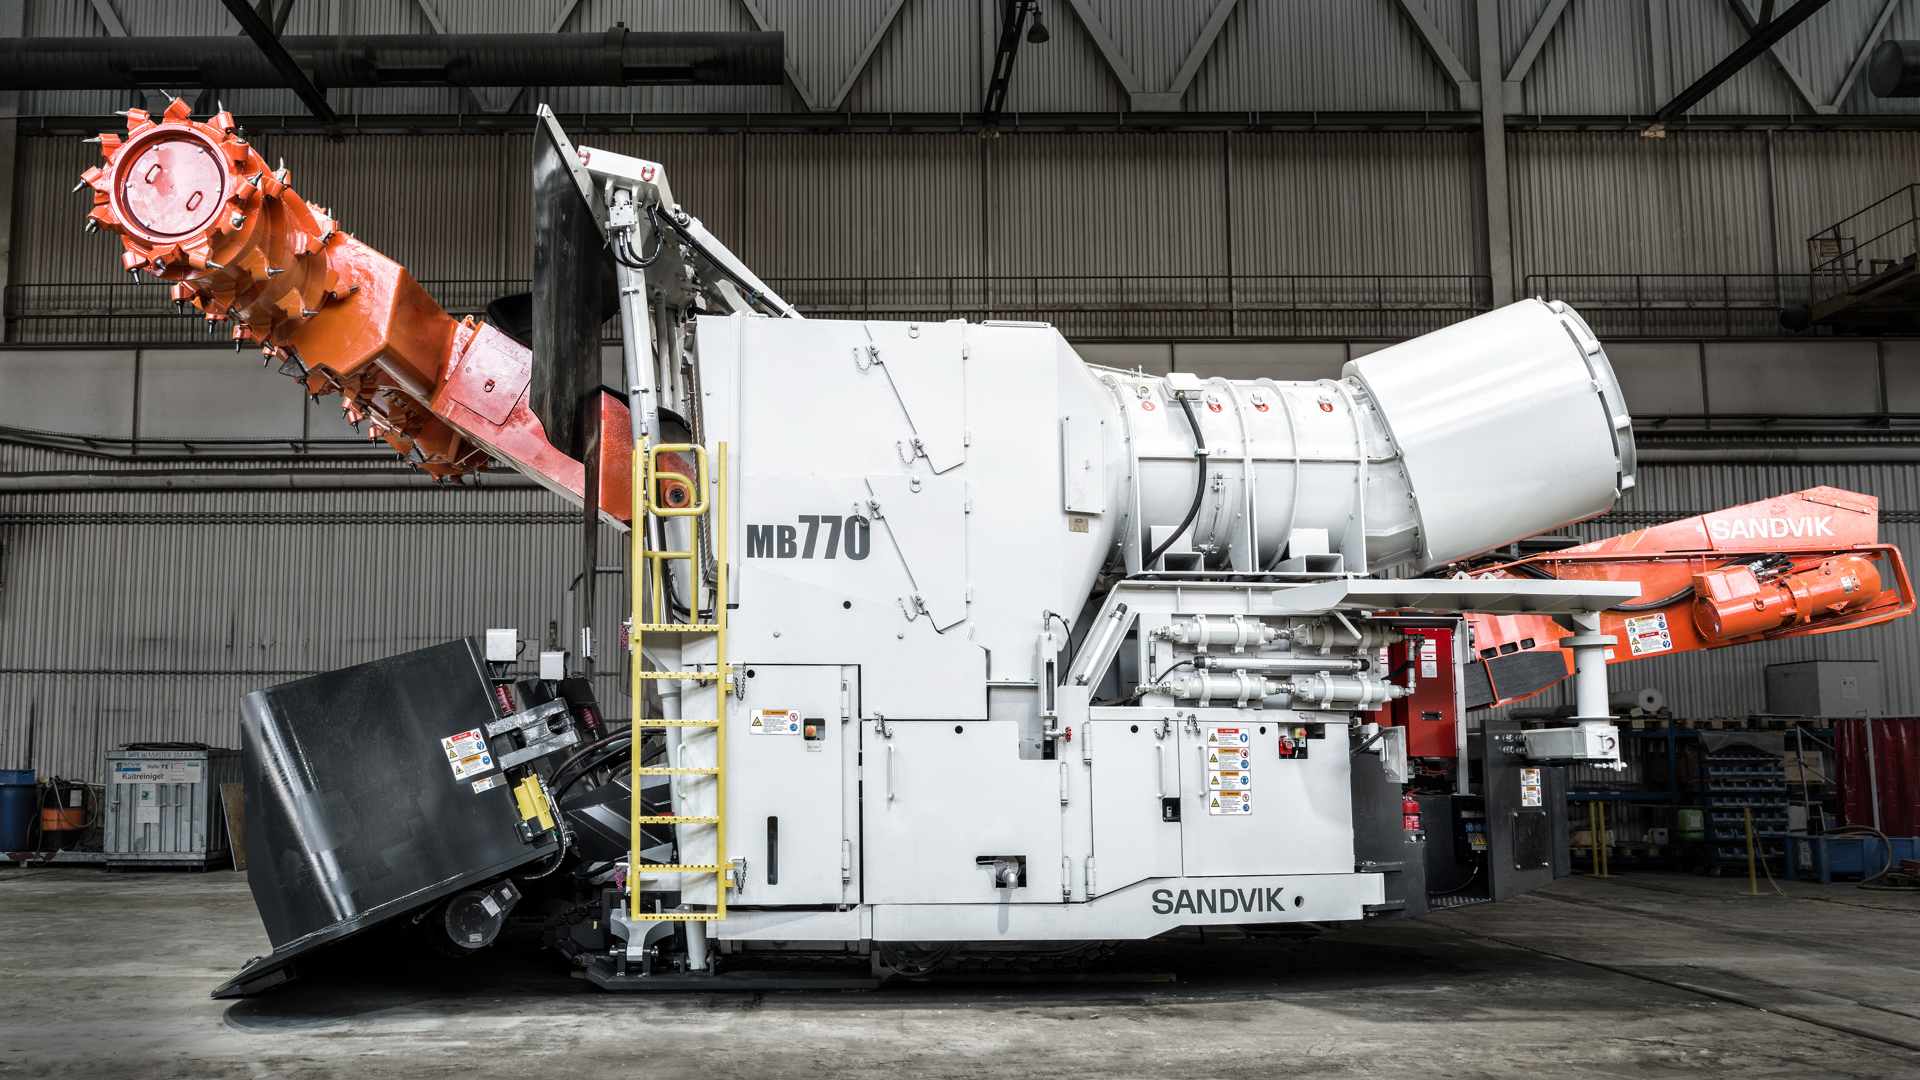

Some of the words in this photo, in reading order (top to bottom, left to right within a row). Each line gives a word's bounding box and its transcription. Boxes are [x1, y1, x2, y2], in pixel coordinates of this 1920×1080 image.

[747, 515, 870, 560] MB770
[1711, 516, 1835, 540] SANDVIK
[122, 772, 165, 781] Kaltreiniger
[1152, 887, 1286, 914] SANDVIK
